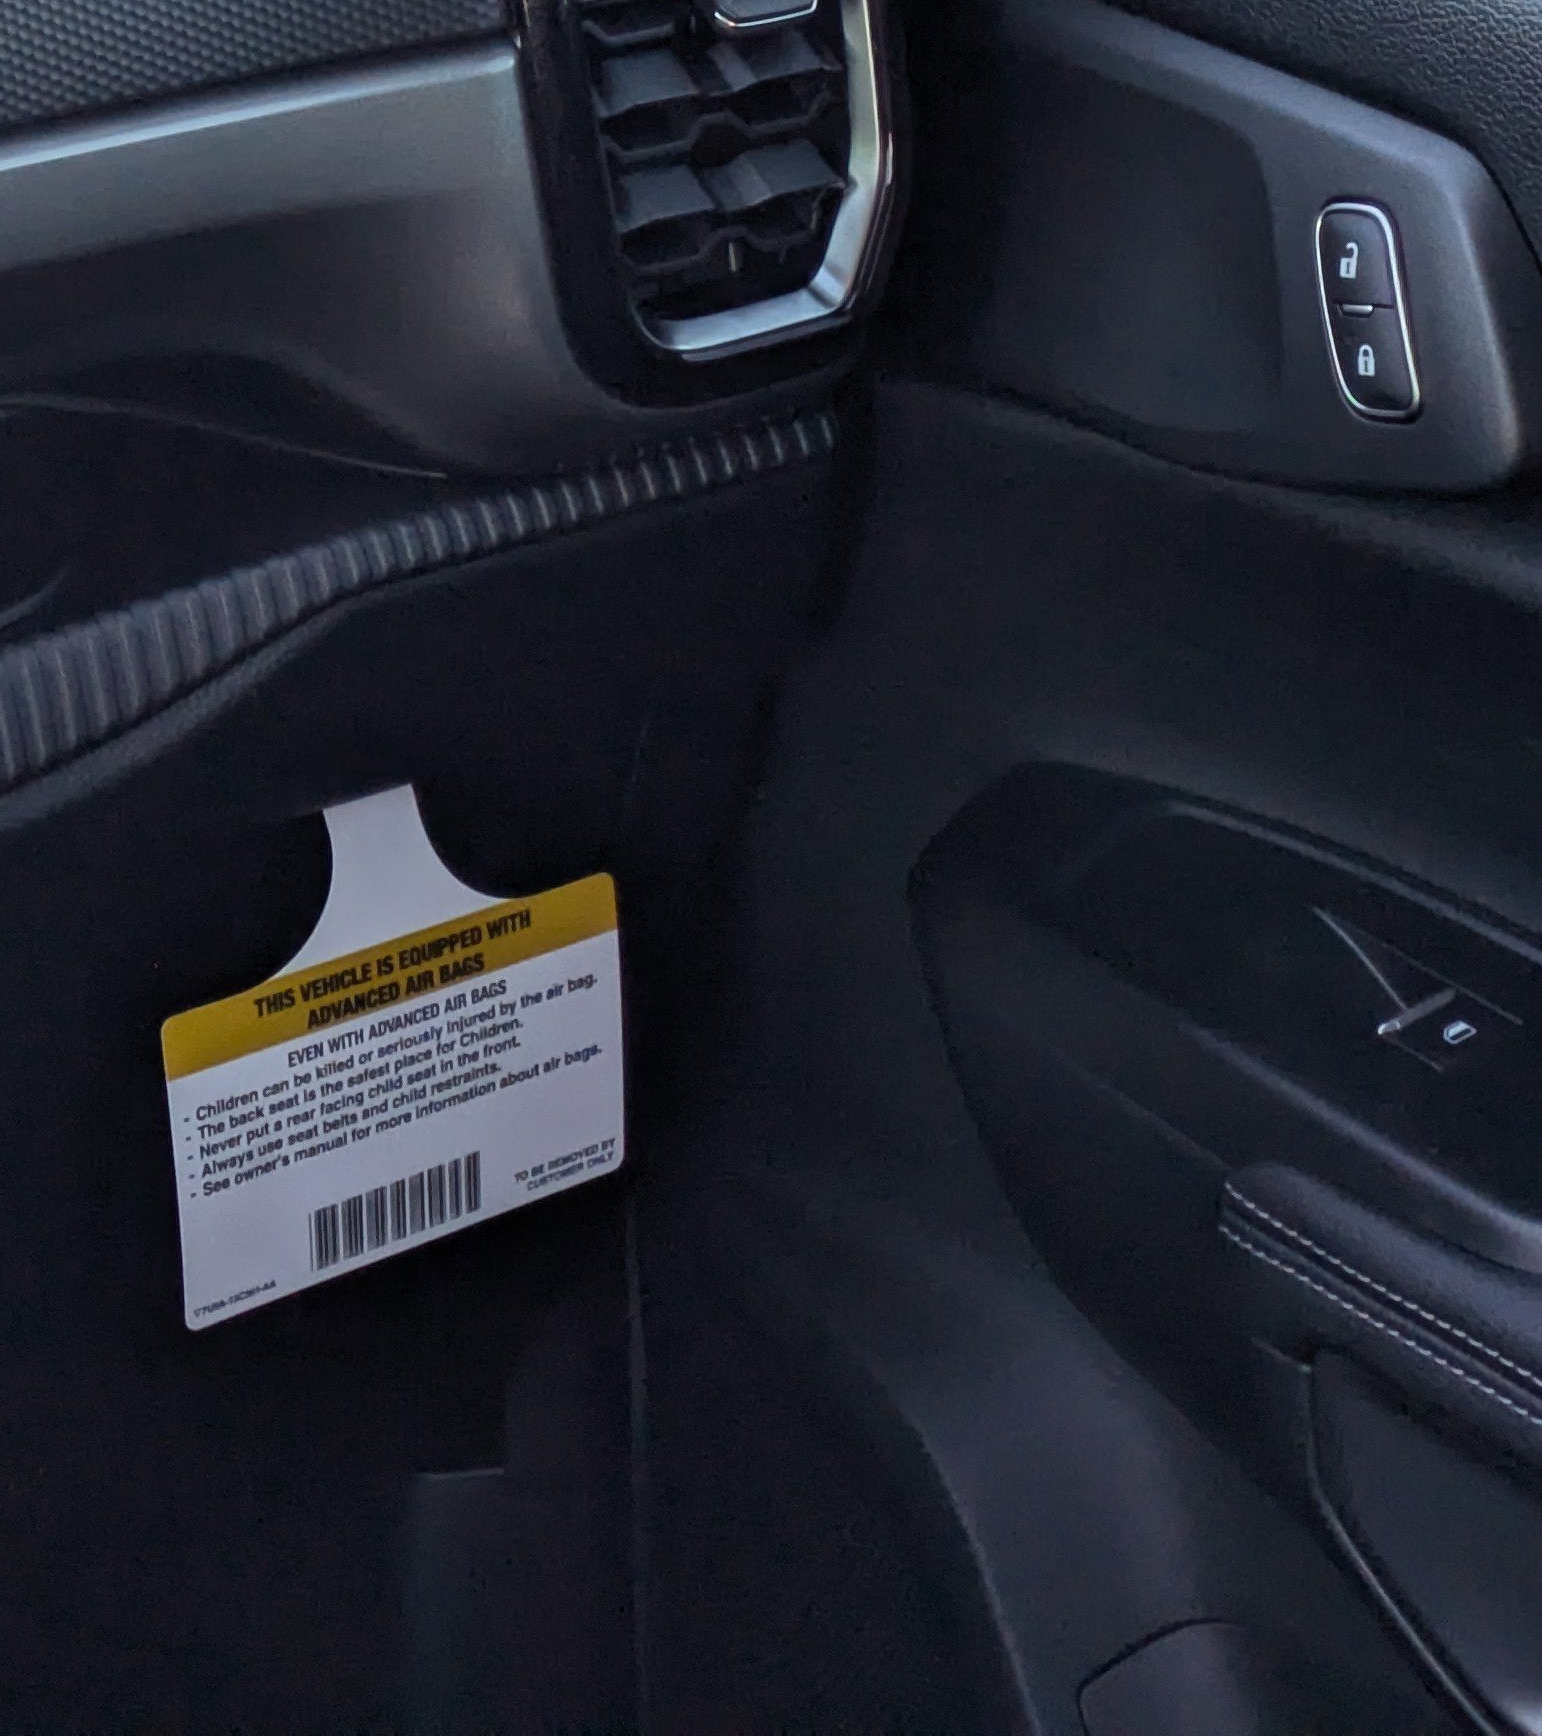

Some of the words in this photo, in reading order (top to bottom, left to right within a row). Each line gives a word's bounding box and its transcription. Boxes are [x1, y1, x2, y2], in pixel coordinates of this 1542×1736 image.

[254, 988, 296, 1018] THIS
[299, 962, 372, 1002] VEHICLE
[377, 954, 394, 976] IS
[399, 926, 482, 970] EQUIPPED
[486, 909, 531, 939] WITH
[308, 982, 401, 1029] ADVANCED
[405, 970, 434, 995] AIR
[439, 953, 485, 983] BAGS
[195, 1090, 258, 1121] Children
[262, 1079, 289, 1098] can
[293, 1071, 312, 1087] be
[316, 1055, 354, 1080] killed
[358, 1049, 373, 1065] or
[377, 1026, 443, 1059] seriously
[447, 1008, 495, 1033] injured
[499, 1001, 516, 1017] by
[520, 991, 542, 1009] the
[546, 984, 564, 1000] air
[567, 973, 597, 994] bag.
[198, 1120, 225, 1140] The
[229, 1105, 265, 1128] back
[269, 1094, 299, 1115] seat
[303, 1089, 316, 1102] is
[320, 1080, 343, 1097] the
[347, 1063, 390, 1088] safest
[394, 1047, 432, 1074] place
[436, 1041, 455, 1056] for
[460, 1018, 524, 1048] Children.
[288, 1042, 324, 1068] EVEN
[327, 1028, 364, 1054] WITH
[369, 1003, 440, 1042] ADVANCED
[444, 993, 467, 1014] AIR
[471, 979, 507, 1005] BAGS
[200, 1133, 242, 1160] Never
[246, 1124, 269, 1146] put
[274, 1121, 283, 1132] a
[287, 1108, 316, 1128] rear
[320, 1091, 365, 1117] facing
[368, 1075, 403, 1099] child
[407, 1065, 437, 1085] seat
[440, 1059, 454, 1073] in
[457, 1050, 479, 1067] the
[483, 1036, 521, 1058] front.
[201, 1148, 254, 1178] Always
[258, 1138, 283, 1157] use
[287, 1126, 319, 1146] seat
[323, 1111, 358, 1133] belts
[362, 1100, 388, 1120] and
[392, 1086, 427, 1109] child
[430, 1061, 501, 1096] restraints.
[203, 1177, 231, 1197] See
[234, 1157, 290, 1185] owner's
[294, 1132, 347, 1162] manual
[351, 1125, 373, 1143] for
[376, 1111, 412, 1133] more
[416, 1080, 497, 1119] information
[499, 1064, 540, 1089] about
[543, 1057, 561, 1073] air
[564, 1044, 603, 1066] bags.
